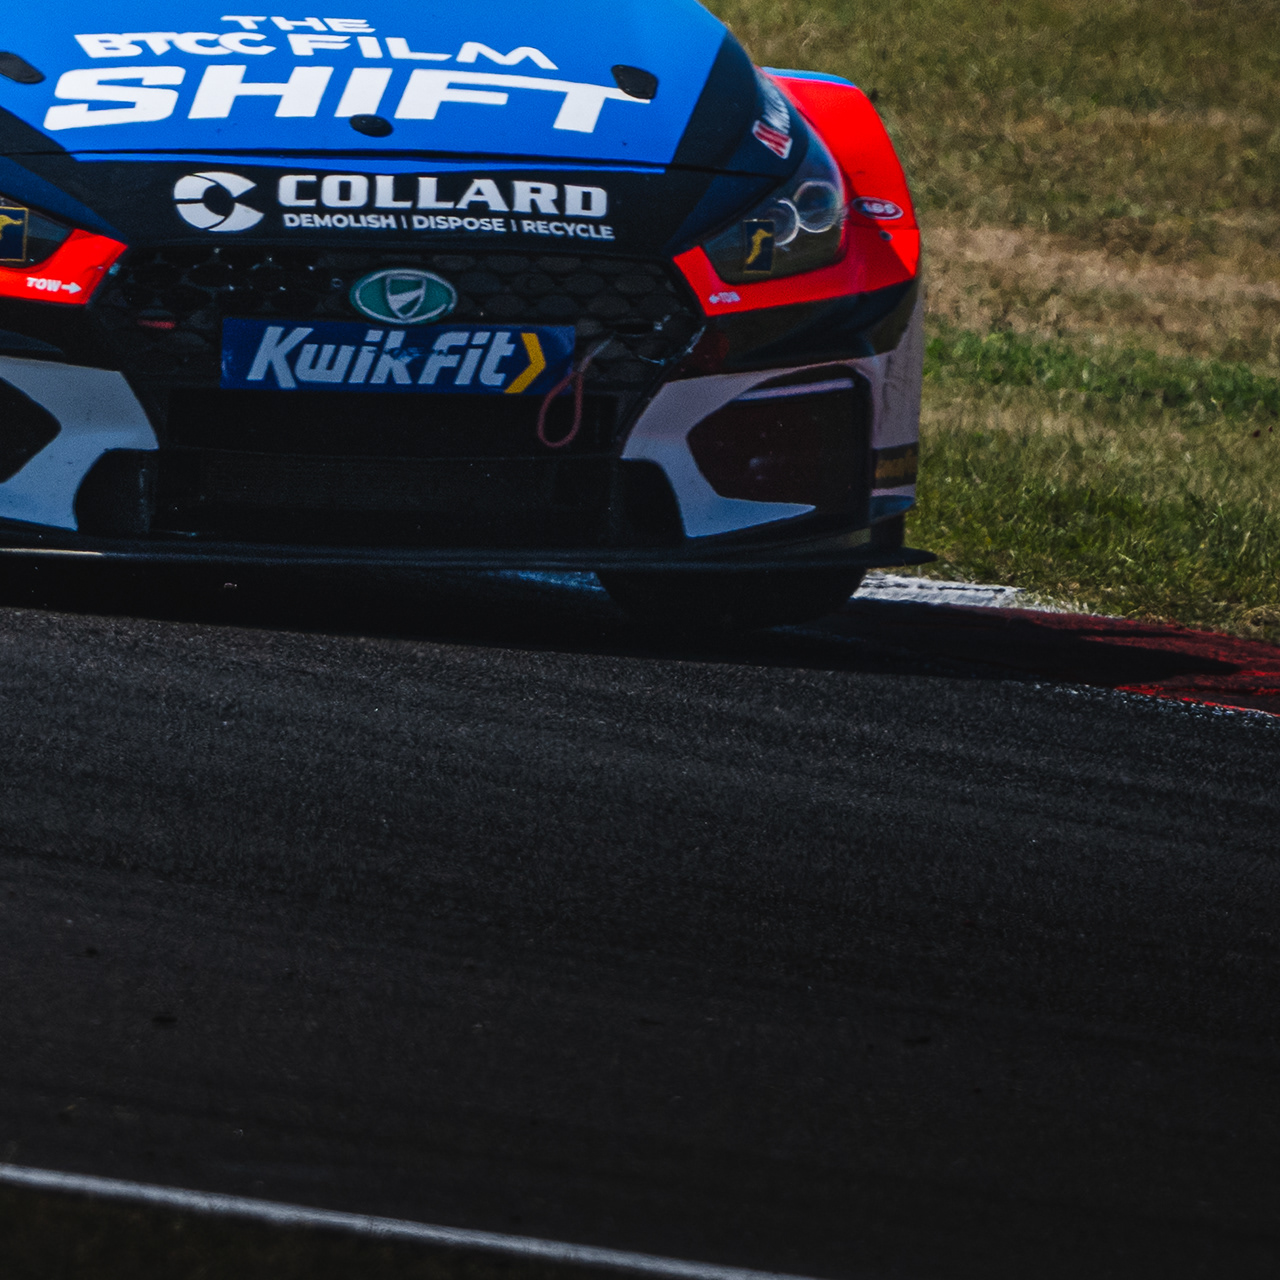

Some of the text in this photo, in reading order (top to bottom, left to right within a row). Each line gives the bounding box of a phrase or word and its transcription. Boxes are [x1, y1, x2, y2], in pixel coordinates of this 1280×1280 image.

[221, 15, 376, 33] THE
[73, 31, 559, 70] BTCC FILM
[43, 64, 651, 134] SHIFT
[277, 174, 608, 219] COLLARD
[282, 212, 616, 240] DEMOLISH DISPOSE RECYCLE
[26, 276, 62, 292] TOW
